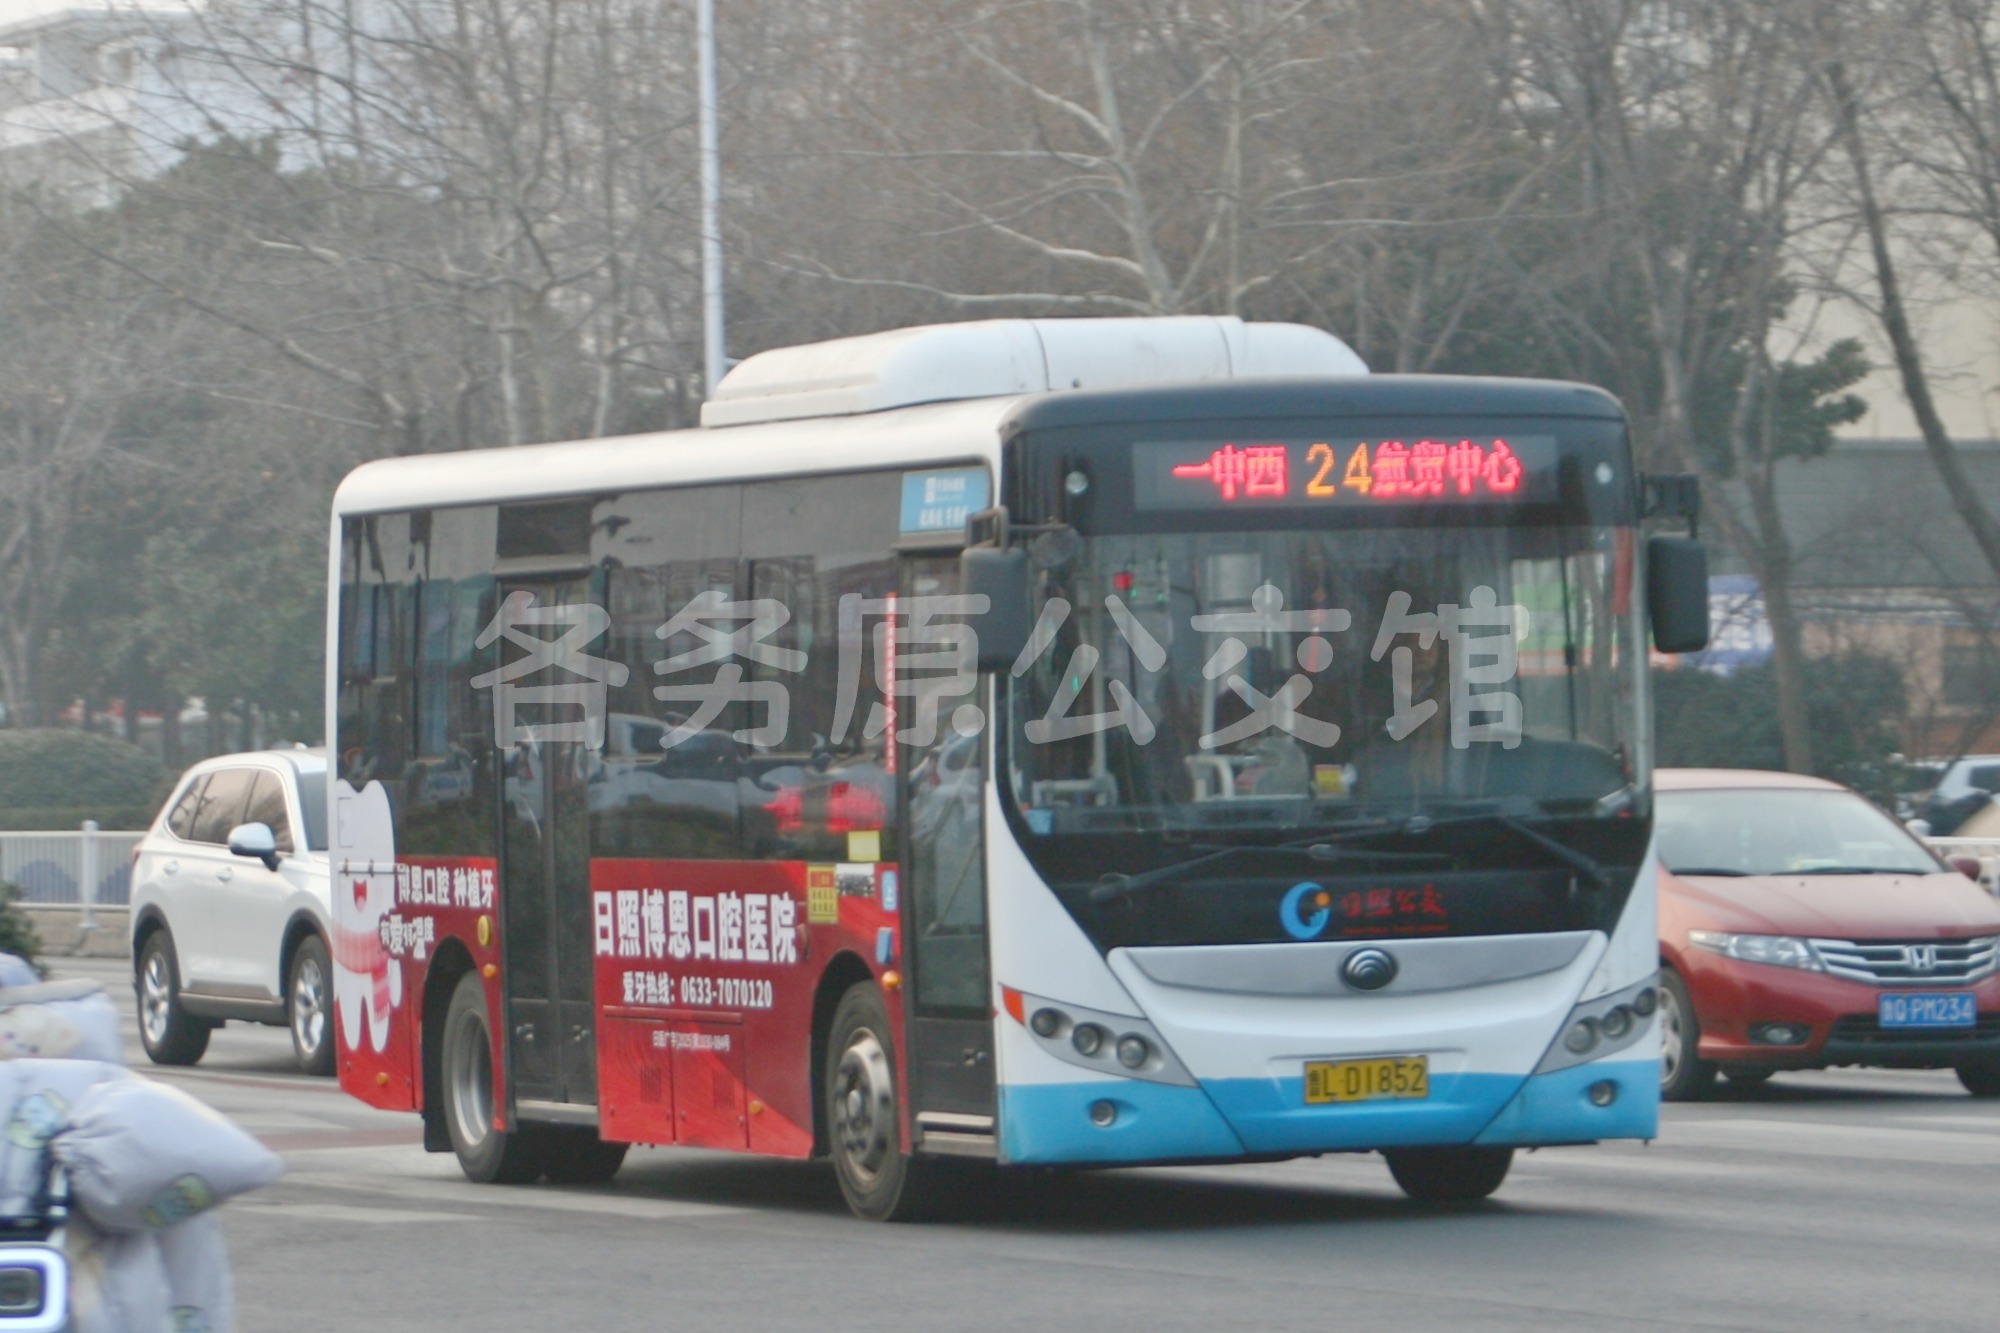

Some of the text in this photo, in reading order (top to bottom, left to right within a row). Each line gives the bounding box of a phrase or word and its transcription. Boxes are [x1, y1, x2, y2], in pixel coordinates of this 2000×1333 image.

[1306, 441, 1372, 496] 24
[396, 864, 494, 909] 博恩口腔 种植牙
[593, 887, 797, 964] 日照博恩口腔医院
[681, 975, 773, 1008] 0633-7070120
